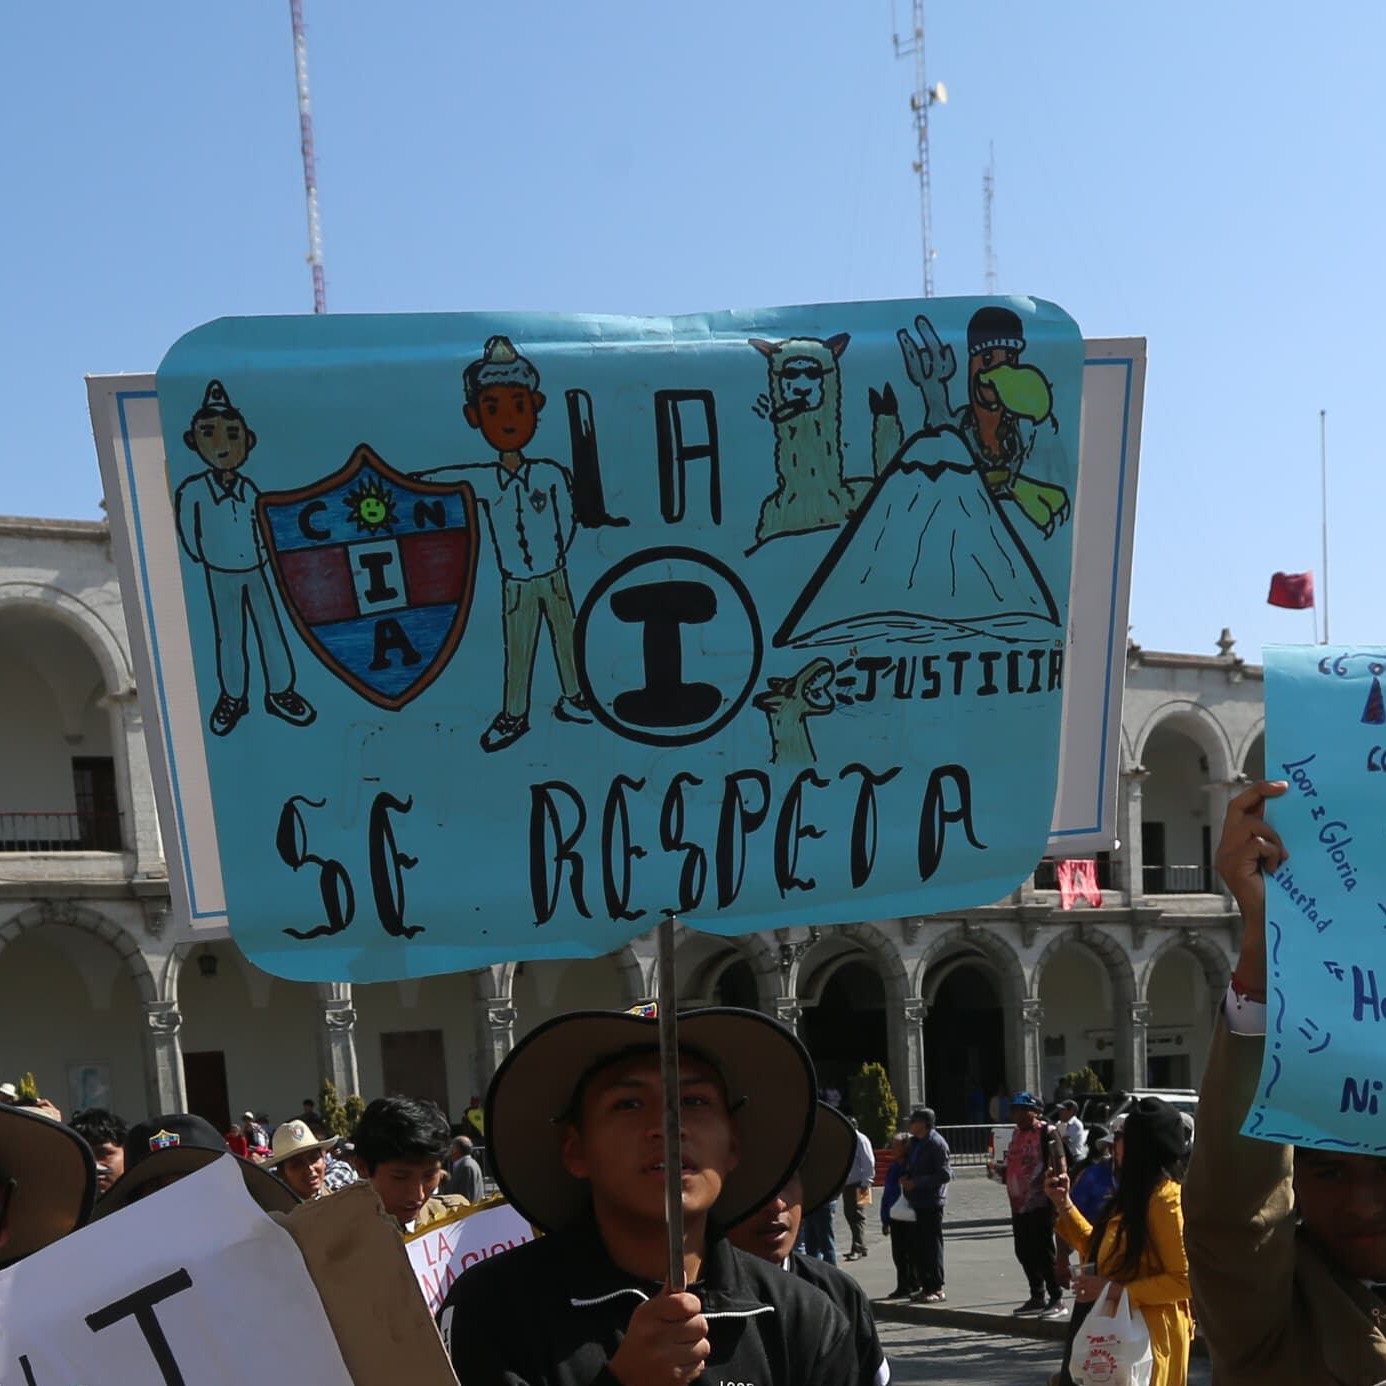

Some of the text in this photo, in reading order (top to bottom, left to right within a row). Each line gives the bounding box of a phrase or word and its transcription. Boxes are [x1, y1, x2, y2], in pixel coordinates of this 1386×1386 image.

[568, 387, 724, 528] LA
[609, 580, 723, 728] I
[275, 763, 989, 942] SE RESPETA
[1318, 820, 1358, 893] Gloria
[1339, 1076, 1383, 1116] Ni
[422, 1231, 455, 1267] LA
